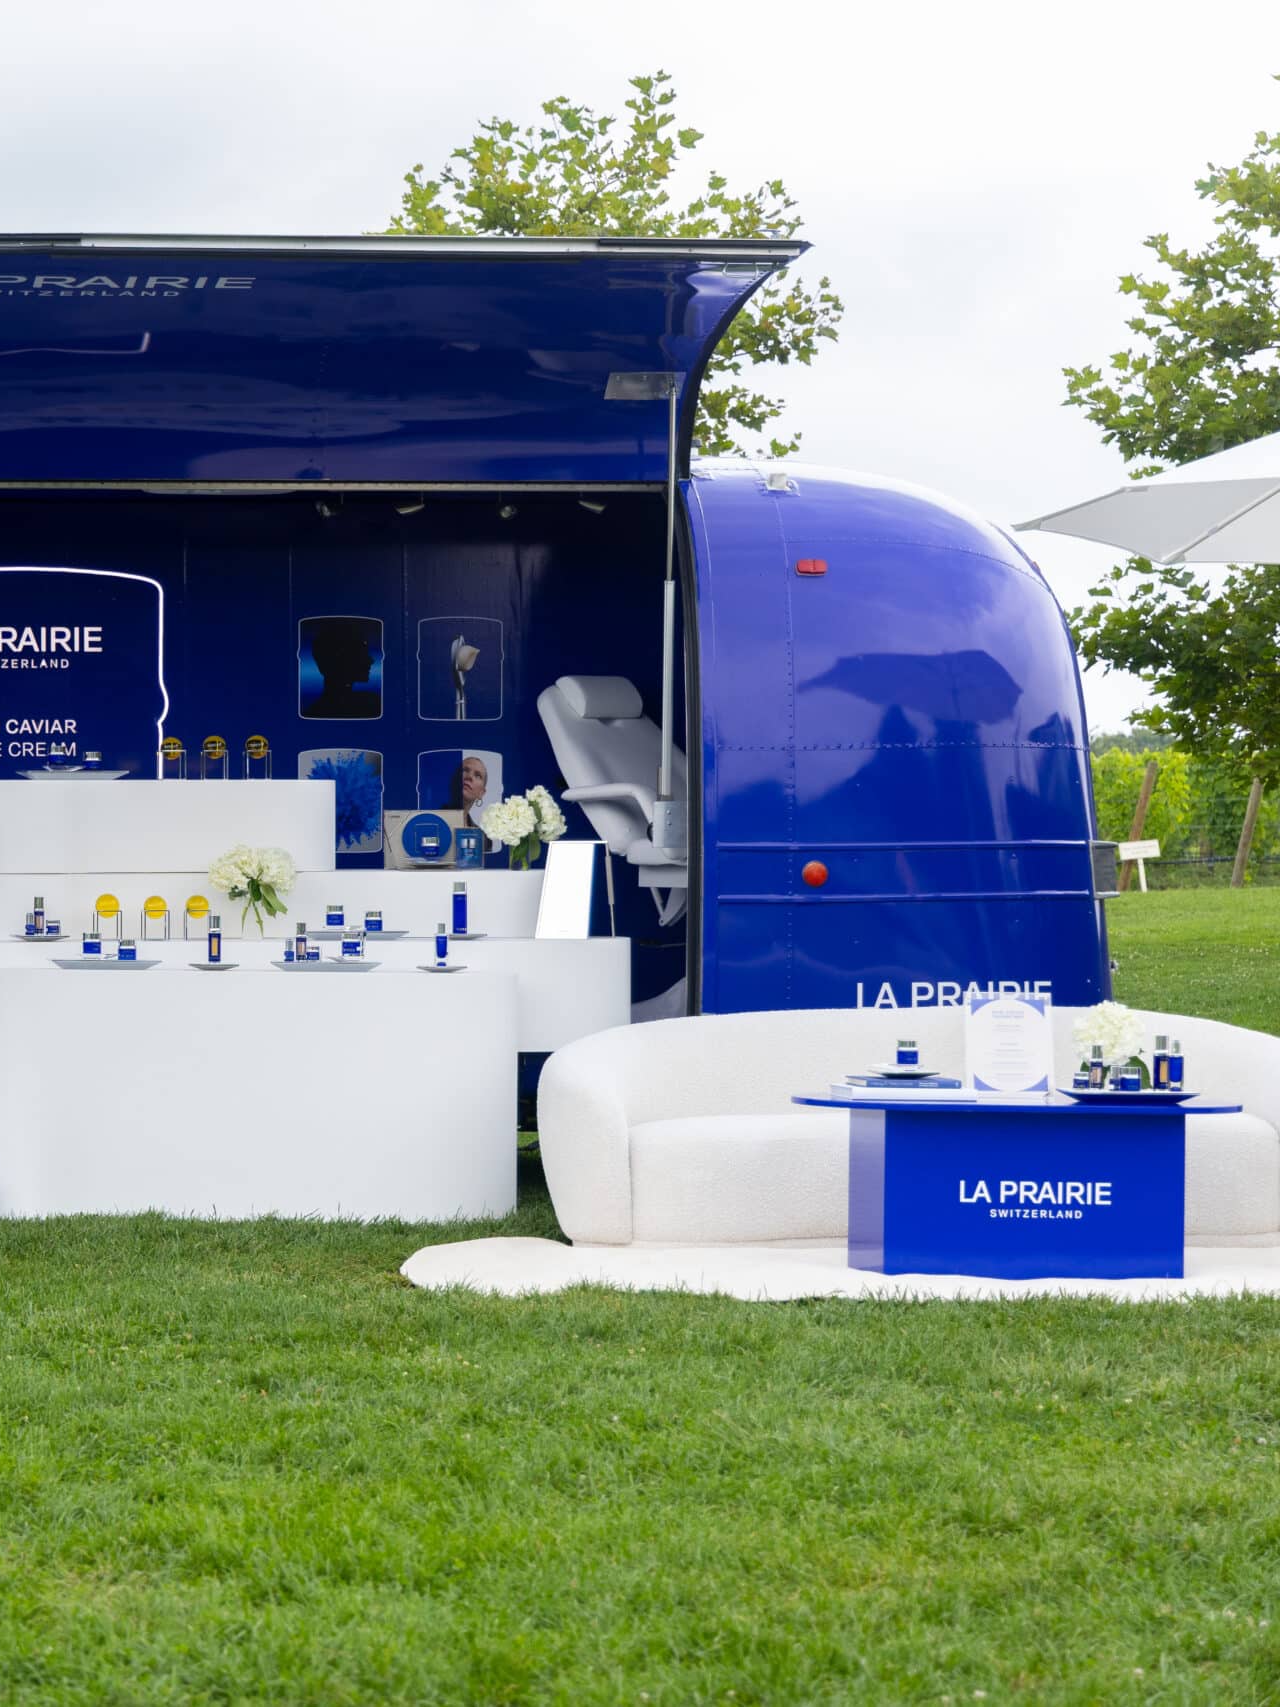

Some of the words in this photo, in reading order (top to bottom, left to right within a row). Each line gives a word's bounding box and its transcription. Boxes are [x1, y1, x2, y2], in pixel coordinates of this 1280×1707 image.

[5, 719, 77, 735] CAVIAR
[856, 982, 899, 1008] LA
[959, 1179, 992, 1204] LA
[999, 1180, 1112, 1206] PRAIRIE
[989, 1208, 1083, 1220] SWITZERLAND
